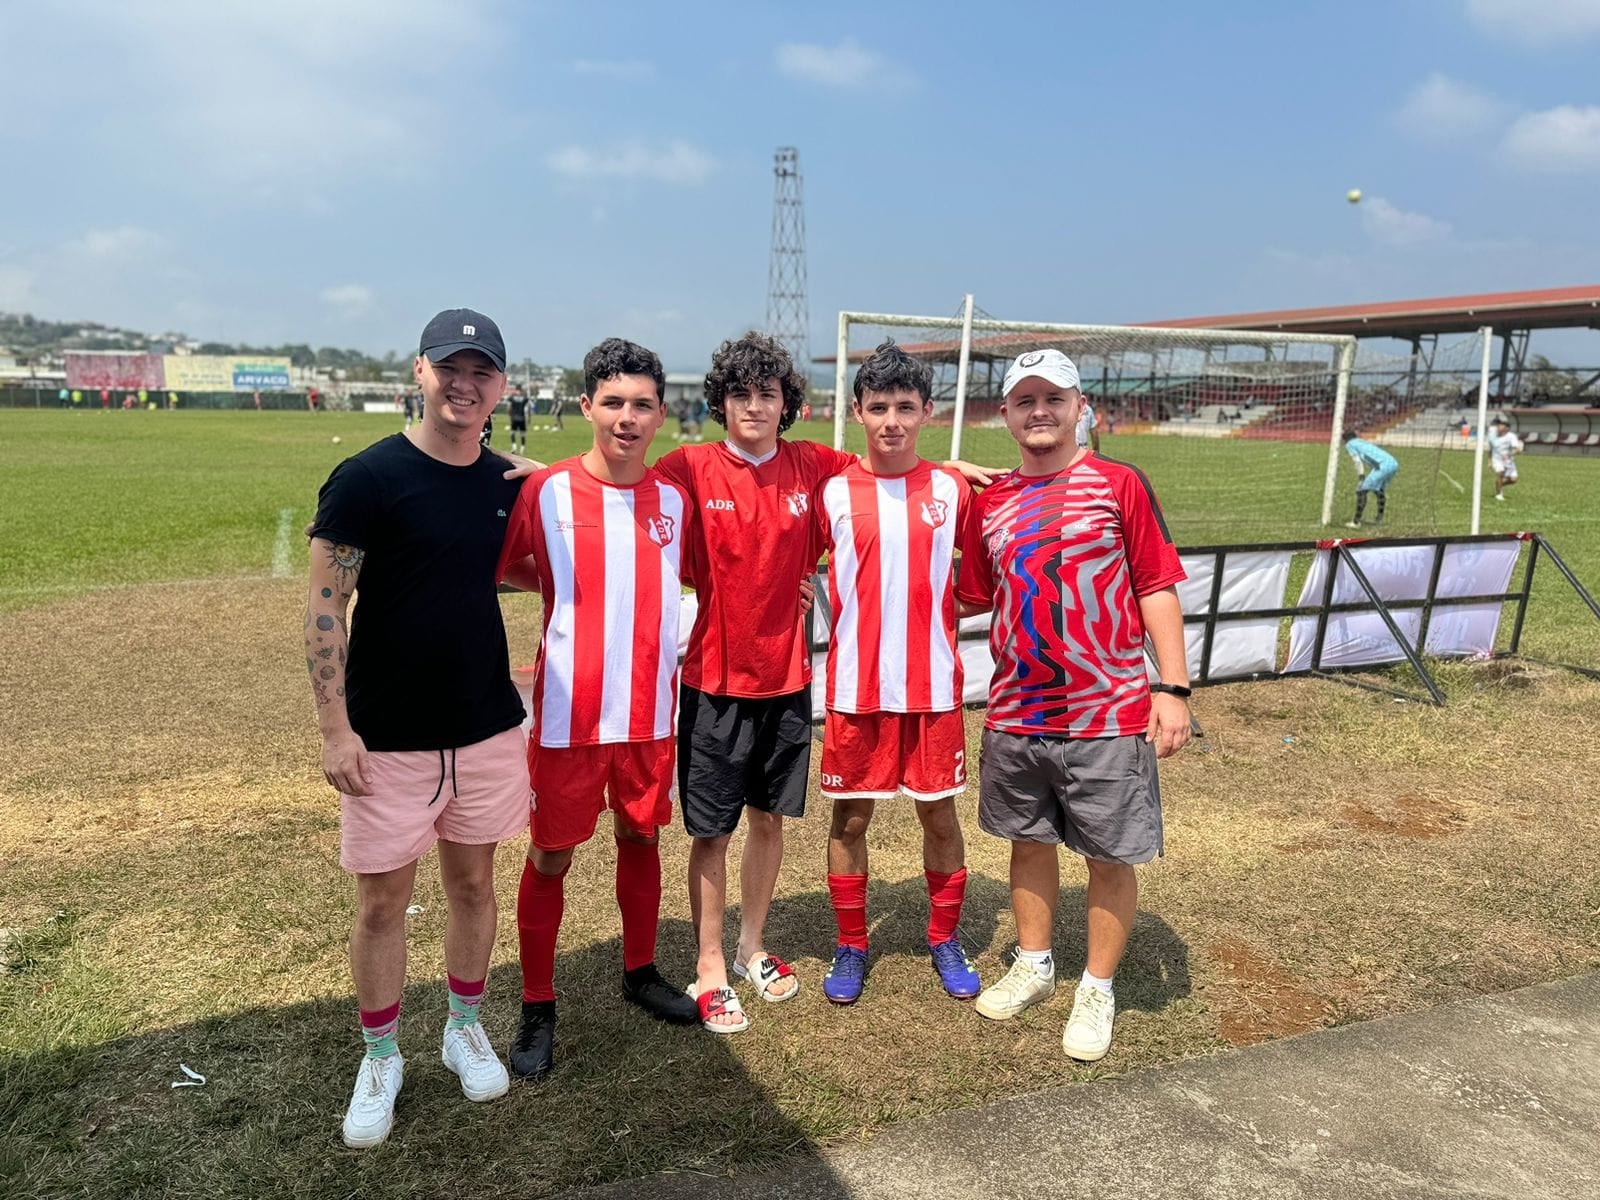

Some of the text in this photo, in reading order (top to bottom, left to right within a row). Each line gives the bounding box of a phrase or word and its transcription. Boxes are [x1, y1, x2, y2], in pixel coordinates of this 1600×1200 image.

[705, 498, 736, 511] ADR
[761, 957, 779, 970] NIKE
[711, 989, 733, 1002] NIKE
